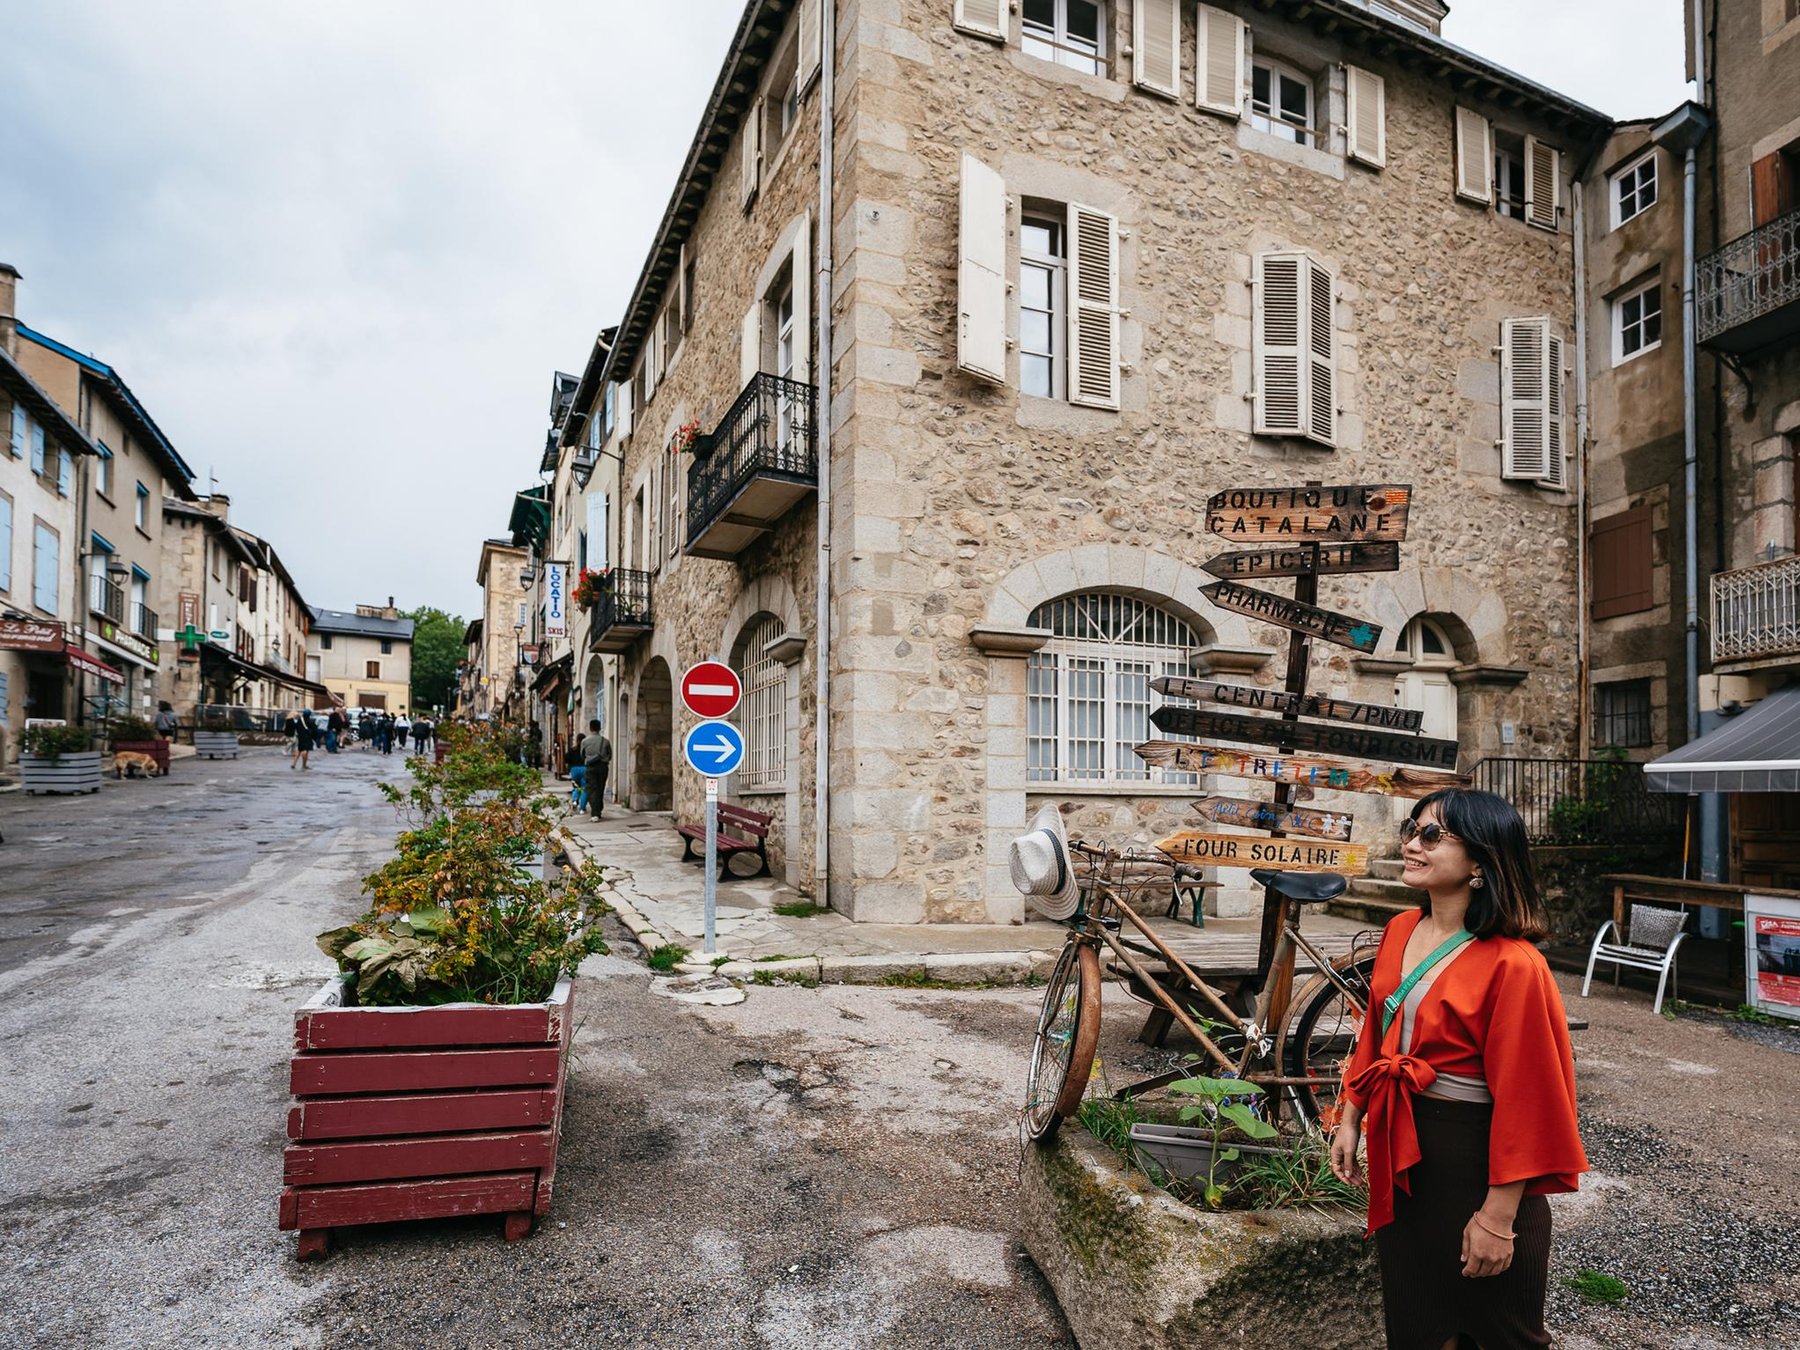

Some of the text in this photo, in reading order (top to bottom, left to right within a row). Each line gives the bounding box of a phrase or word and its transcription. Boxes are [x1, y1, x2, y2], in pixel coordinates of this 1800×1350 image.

[1213, 487, 1374, 510] BOUTIQUE
[1210, 513, 1391, 534] CATALANE
[1164, 678, 1194, 696] LE
[1312, 729, 1457, 765] TOURISME
[1184, 839, 1341, 866] FOUR SOLAIRE
